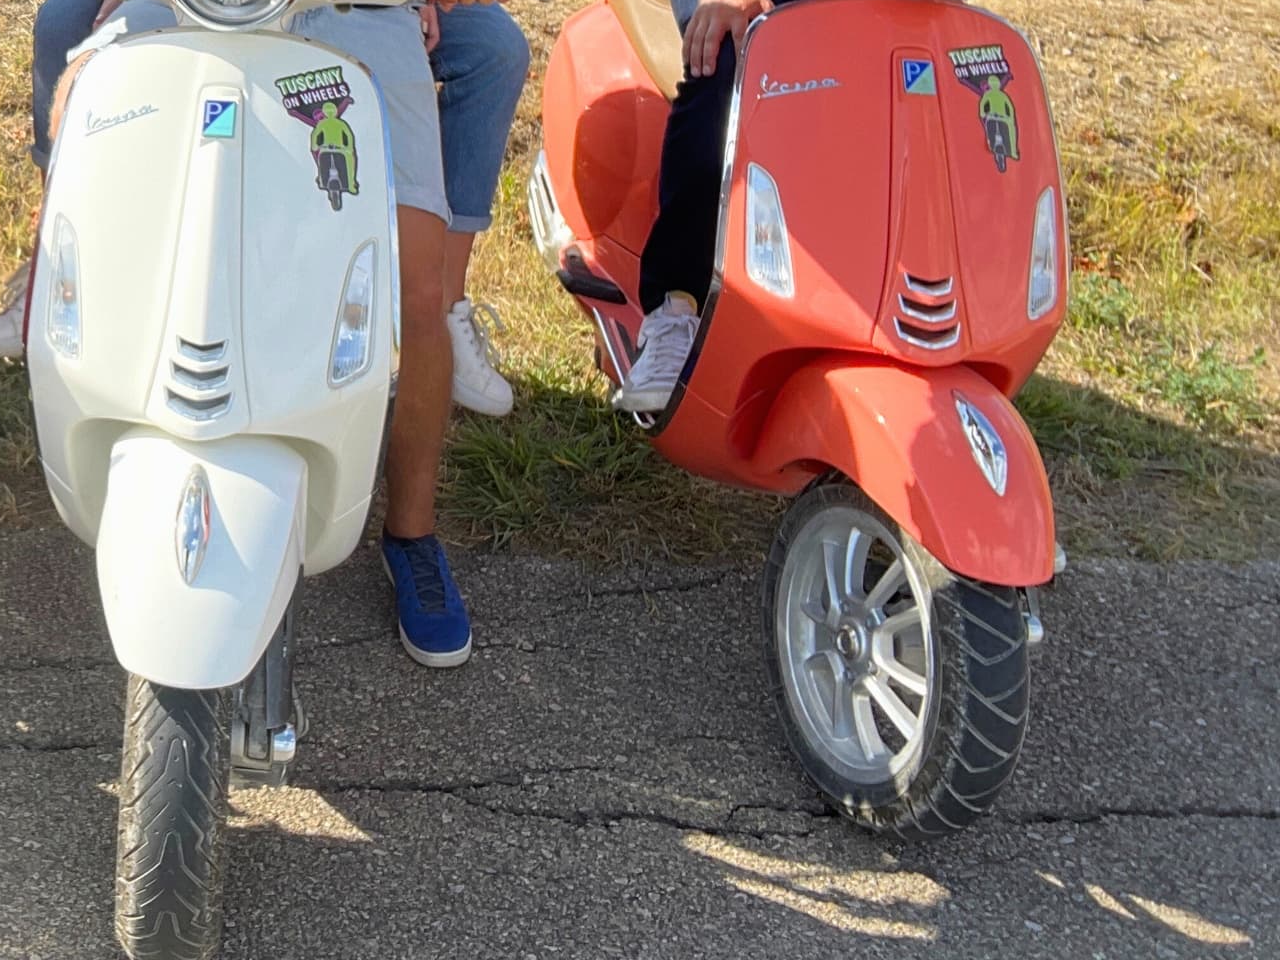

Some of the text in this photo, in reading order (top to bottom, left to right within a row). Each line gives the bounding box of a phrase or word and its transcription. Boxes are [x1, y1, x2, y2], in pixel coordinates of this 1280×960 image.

[948, 45, 1004, 66] TUSCANY
[954, 61, 1010, 78] ON WHEELS
[276, 67, 343, 96] TUSCANY
[283, 84, 349, 109] ON WHEELS
